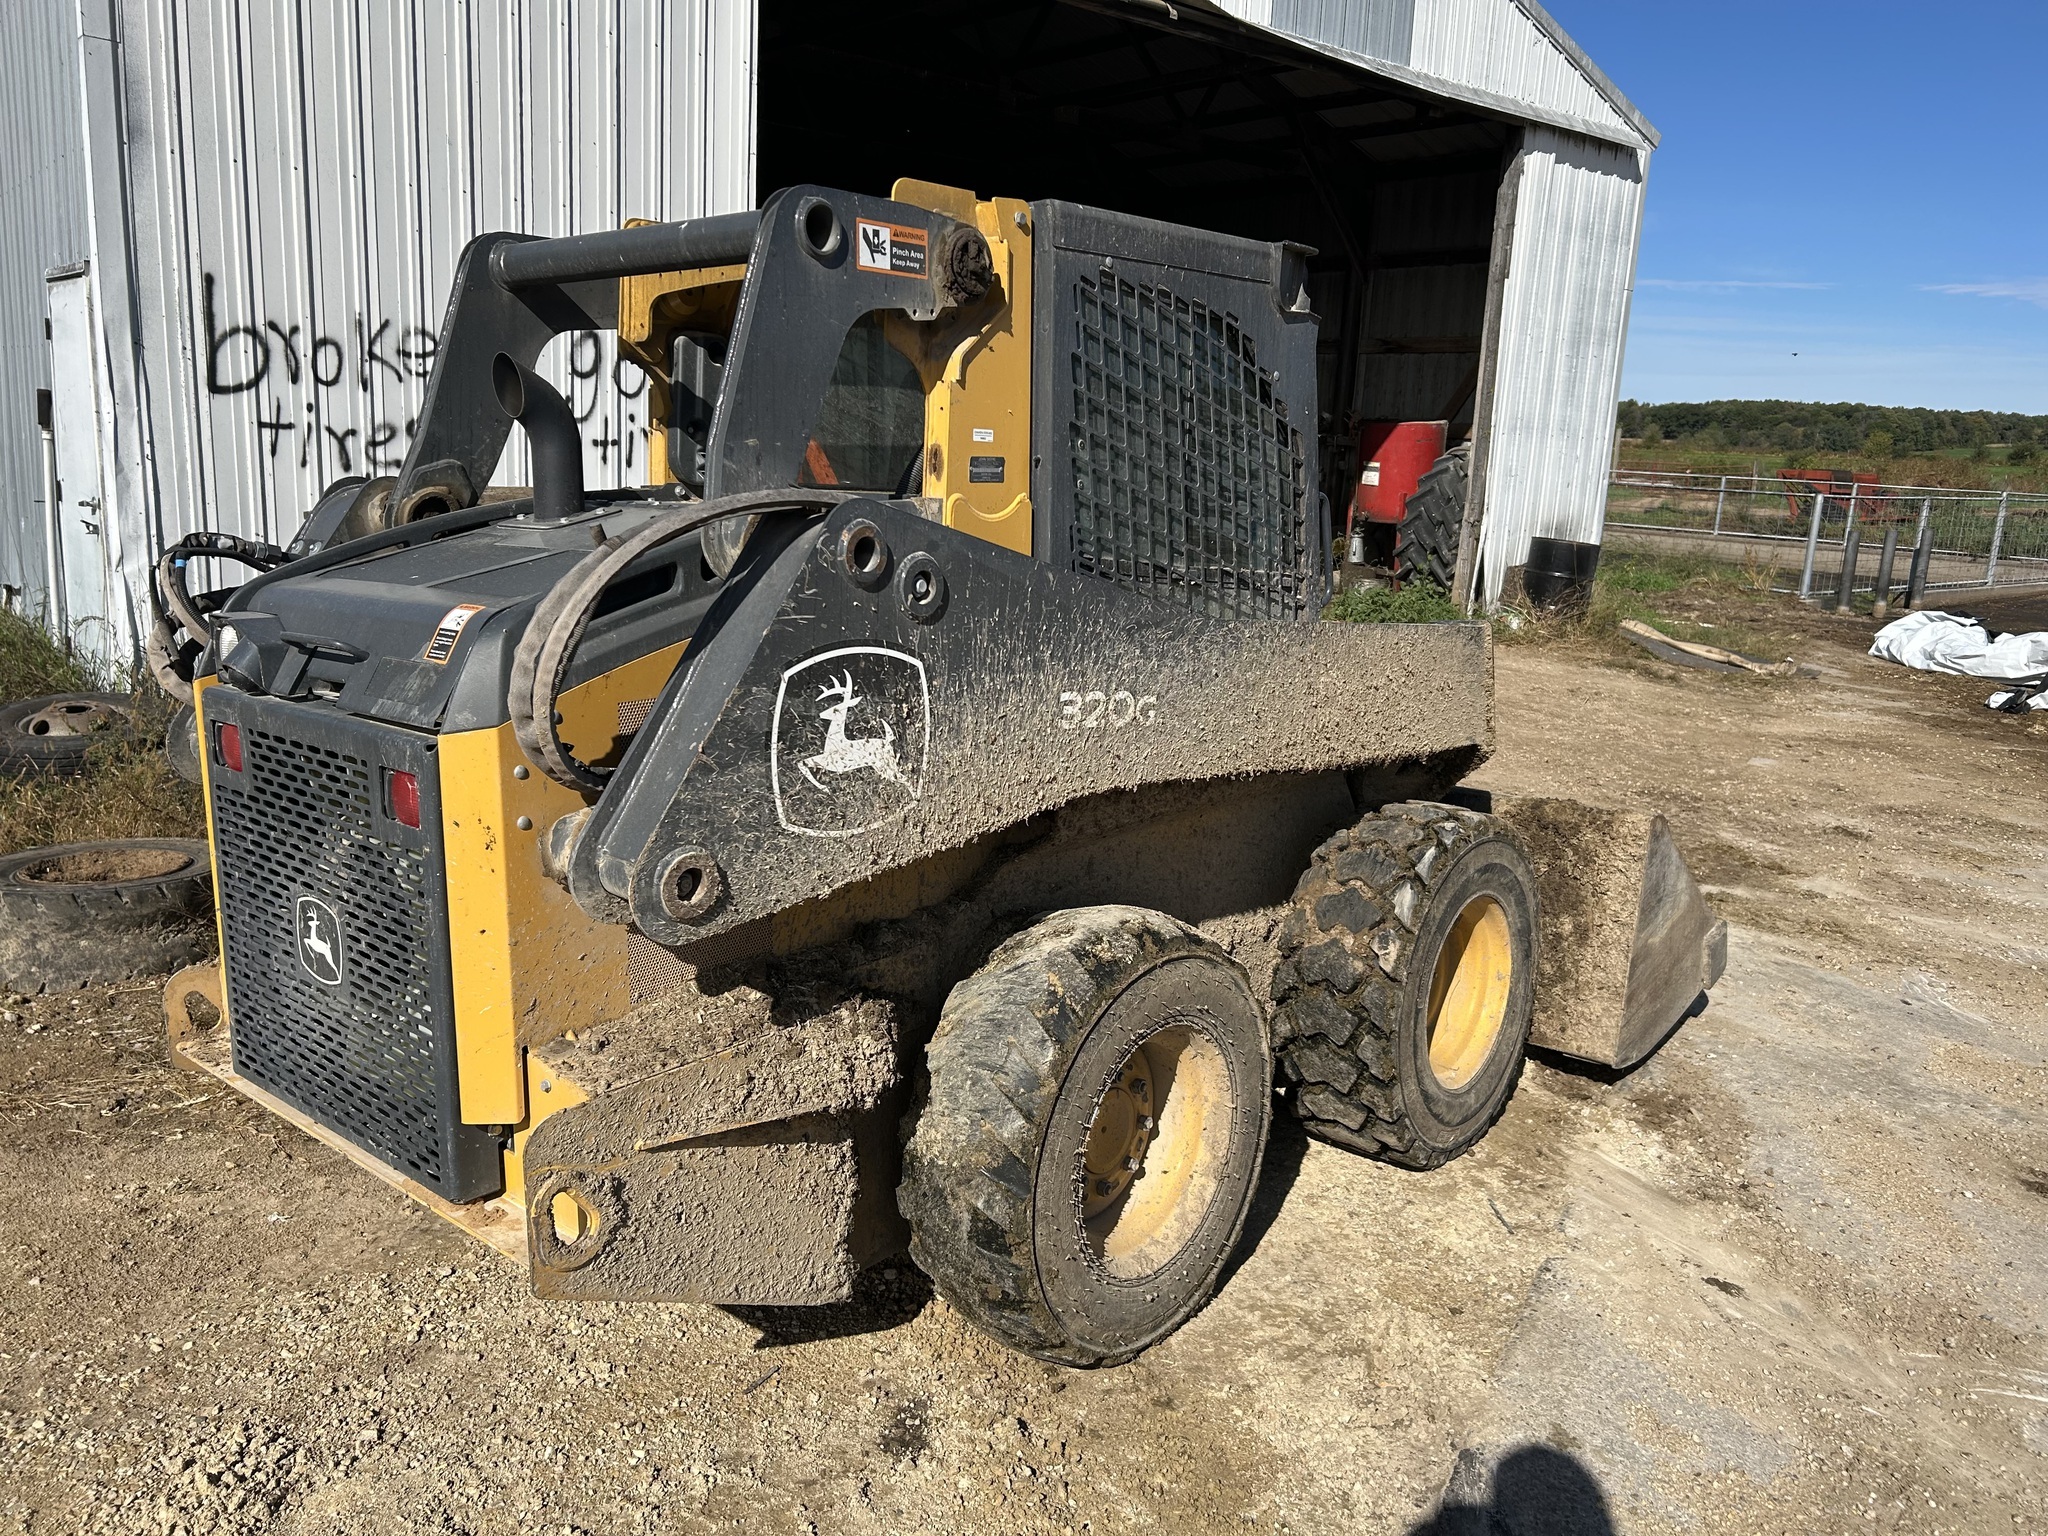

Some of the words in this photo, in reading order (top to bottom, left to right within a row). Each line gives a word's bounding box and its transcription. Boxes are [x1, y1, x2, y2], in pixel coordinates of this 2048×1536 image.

[898, 231, 925, 242] WARNING
[892, 247, 909, 257] Pinch
[910, 250, 924, 259] Area
[892, 258, 905, 267] Keep
[906, 260, 920, 269] Away
[1059, 690, 1158, 730] 320G
